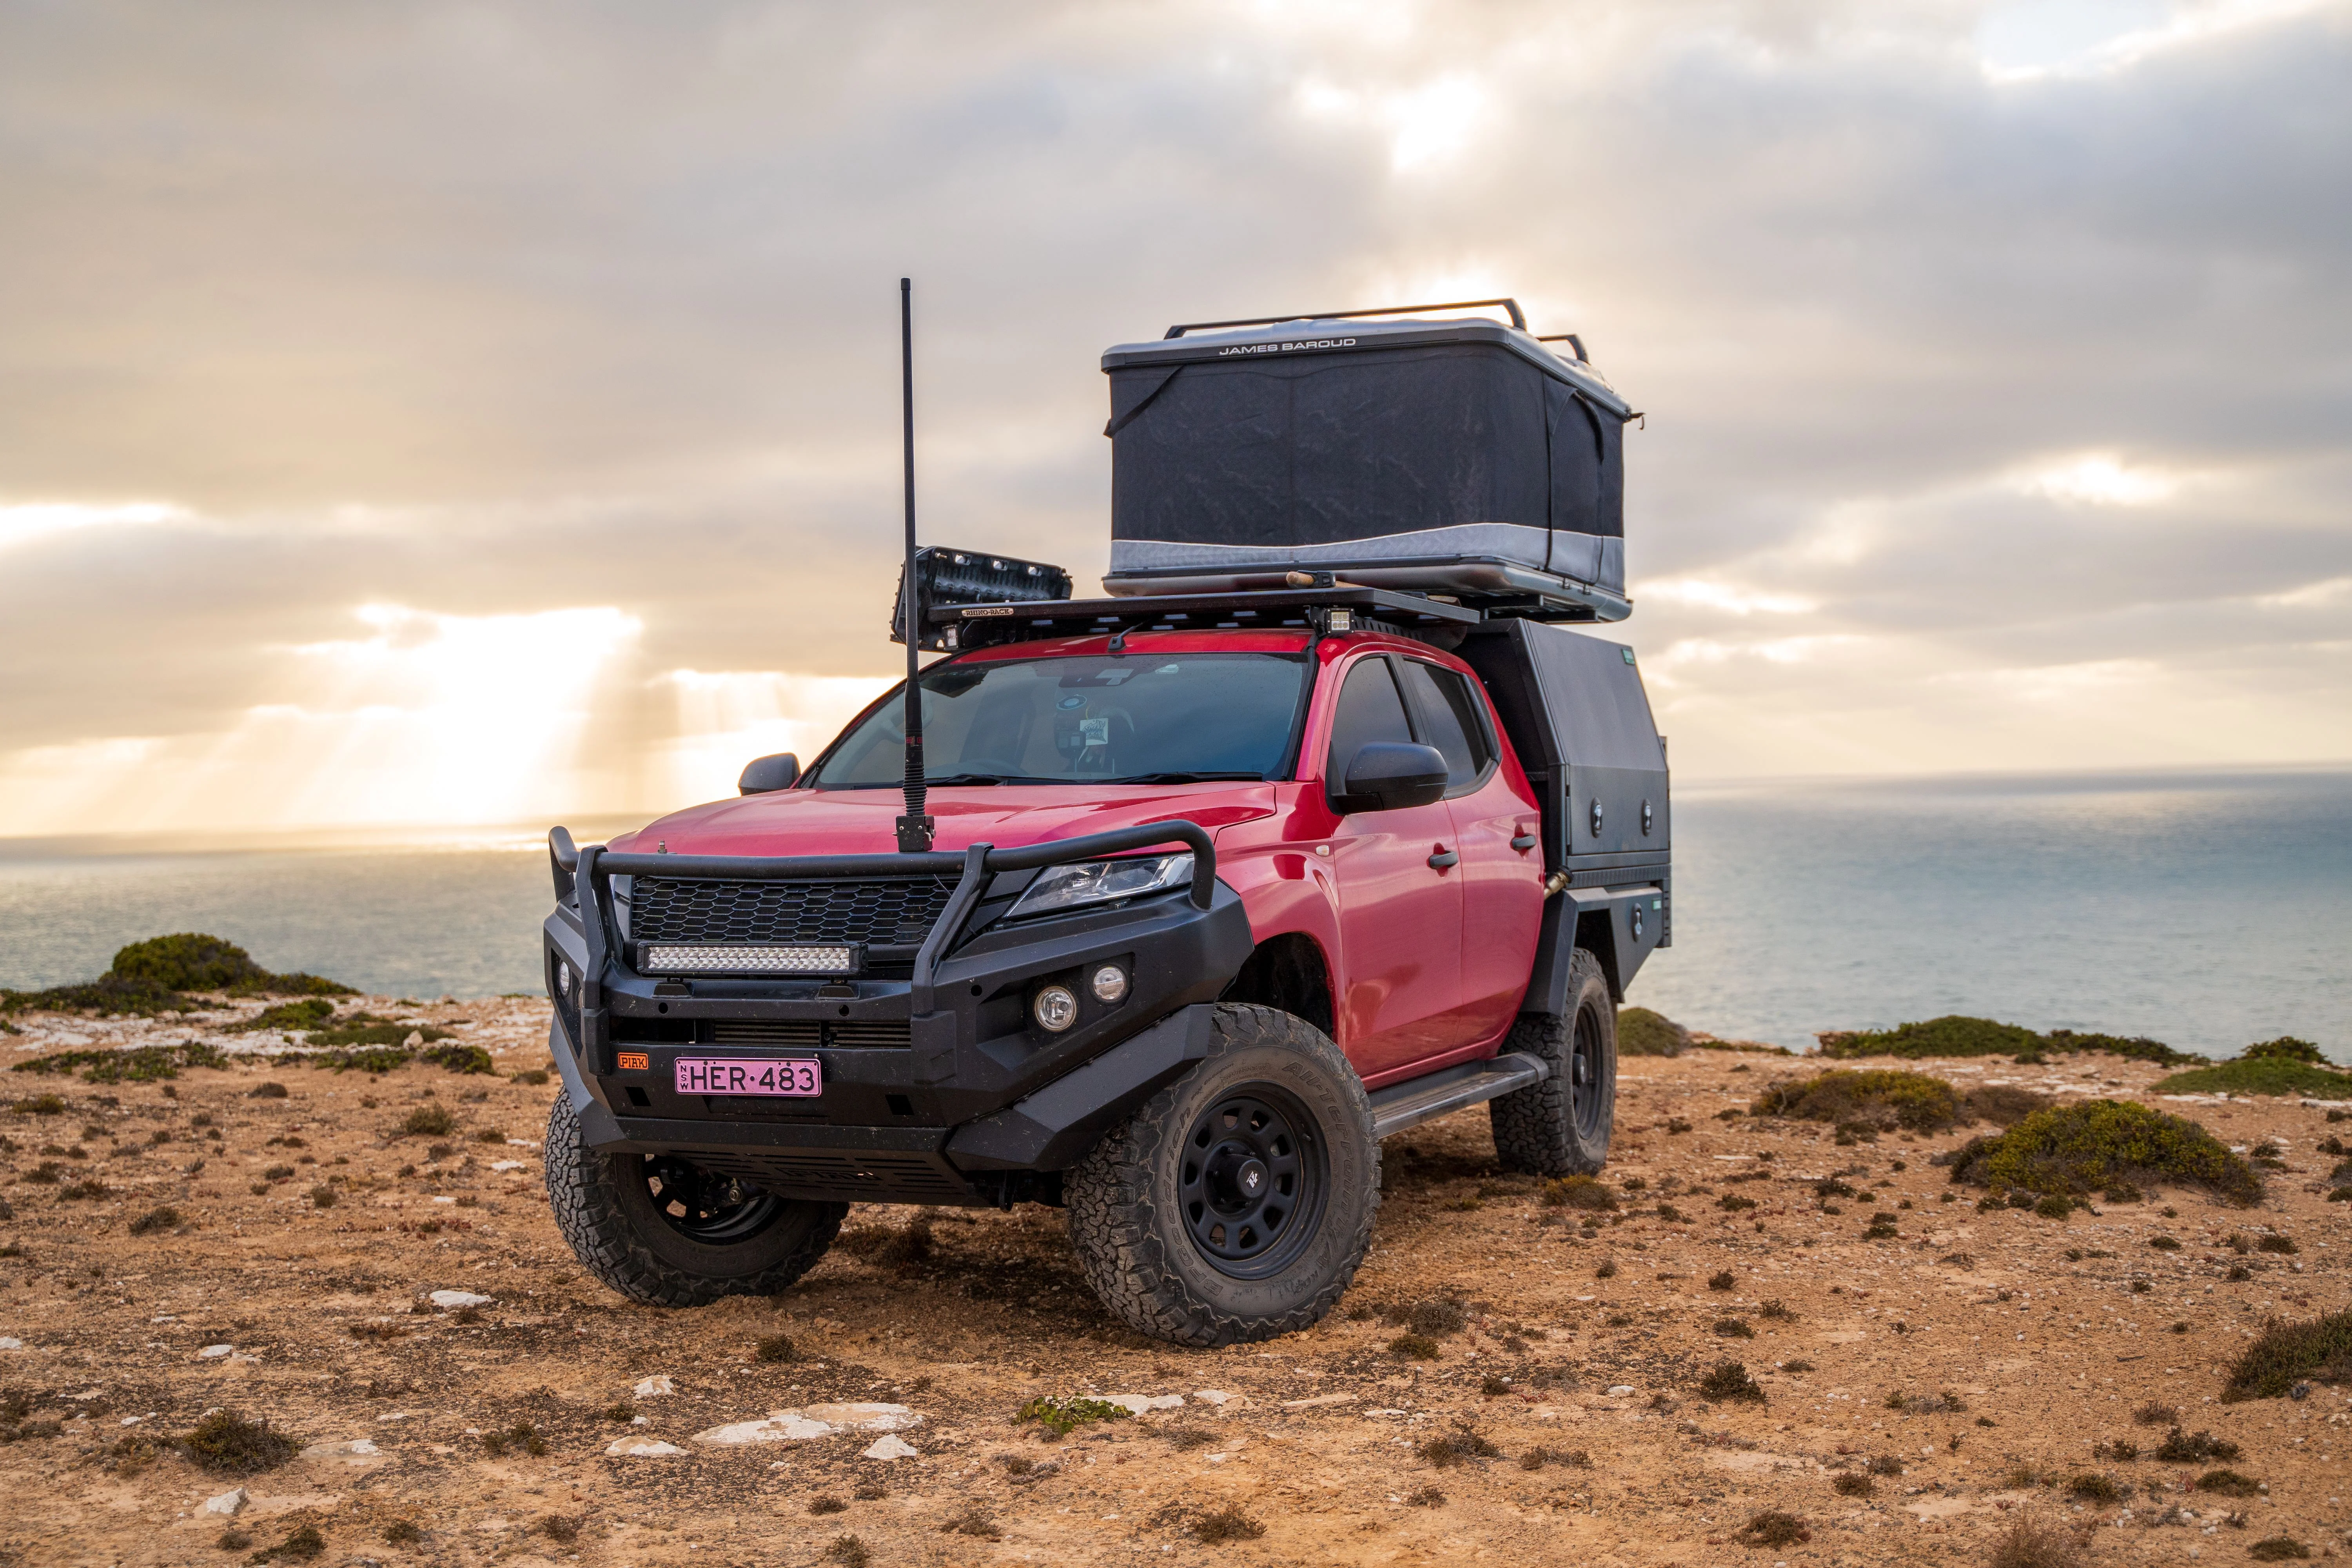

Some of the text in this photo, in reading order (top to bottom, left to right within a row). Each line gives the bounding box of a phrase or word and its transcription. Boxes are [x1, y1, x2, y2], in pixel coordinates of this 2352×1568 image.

[1219, 338, 1356, 355] JAMES BAROUD
[620, 1057, 646, 1068] PIAK
[1163, 1107, 1224, 1296] BFGoodrich
